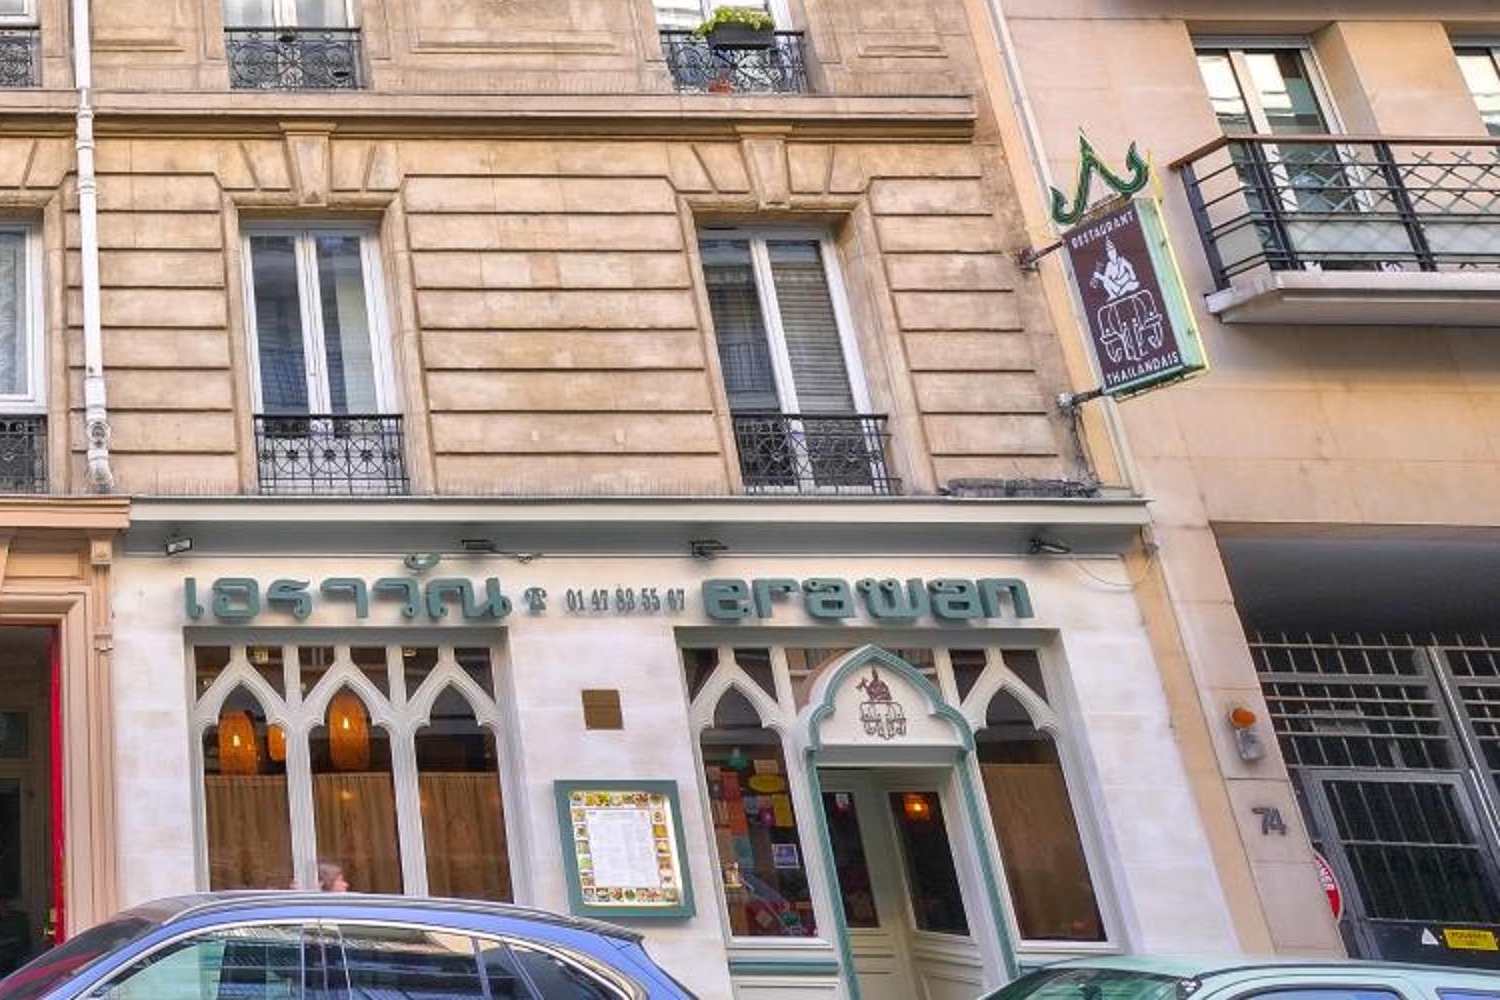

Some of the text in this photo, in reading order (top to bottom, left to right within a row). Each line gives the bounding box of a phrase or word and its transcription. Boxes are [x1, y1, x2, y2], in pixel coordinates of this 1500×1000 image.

[1071, 210, 1136, 249] RESTAURANT
[1106, 351, 1180, 386] THAILANDAIS
[566, 588, 585, 612] 01
[641, 587, 661, 612] 55
[701, 577, 1035, 621] erawan
[1252, 807, 1287, 835] 74
